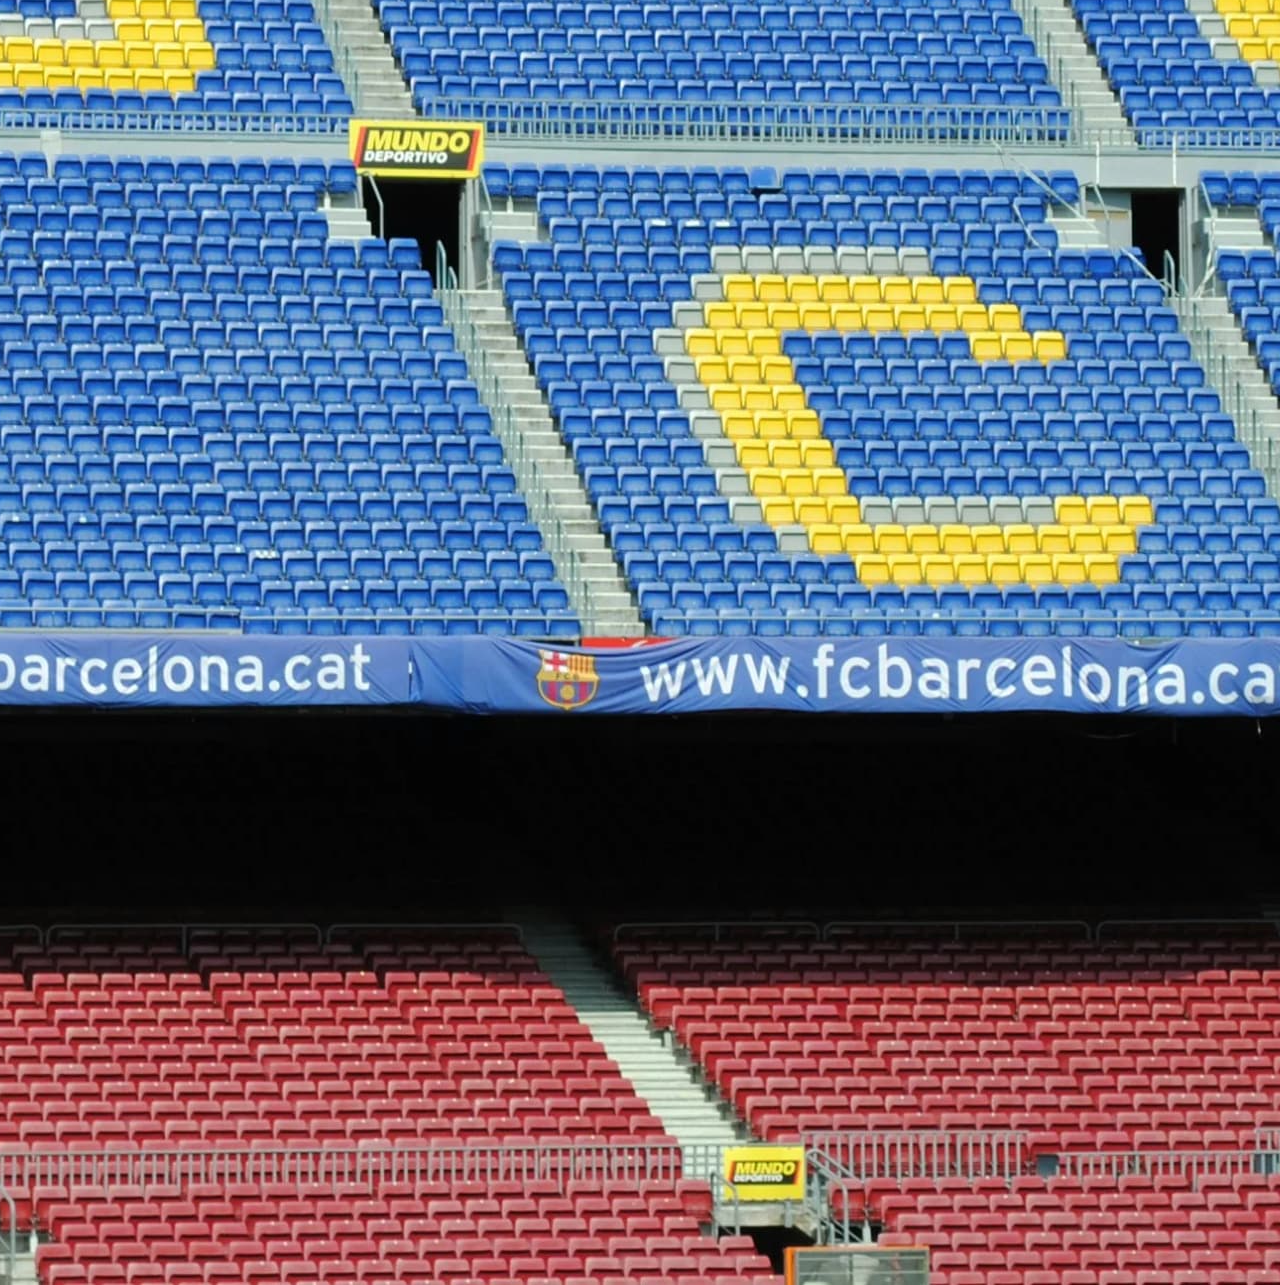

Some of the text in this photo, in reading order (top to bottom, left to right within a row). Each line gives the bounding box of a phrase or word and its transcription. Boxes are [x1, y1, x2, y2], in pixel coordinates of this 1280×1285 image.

[367, 129, 470, 152] MUNDO
[363, 150, 448, 164] DEPORTIVO
[735, 1161, 796, 1175] MUNDO
[733, 1173, 784, 1183] DEPORTIVO
